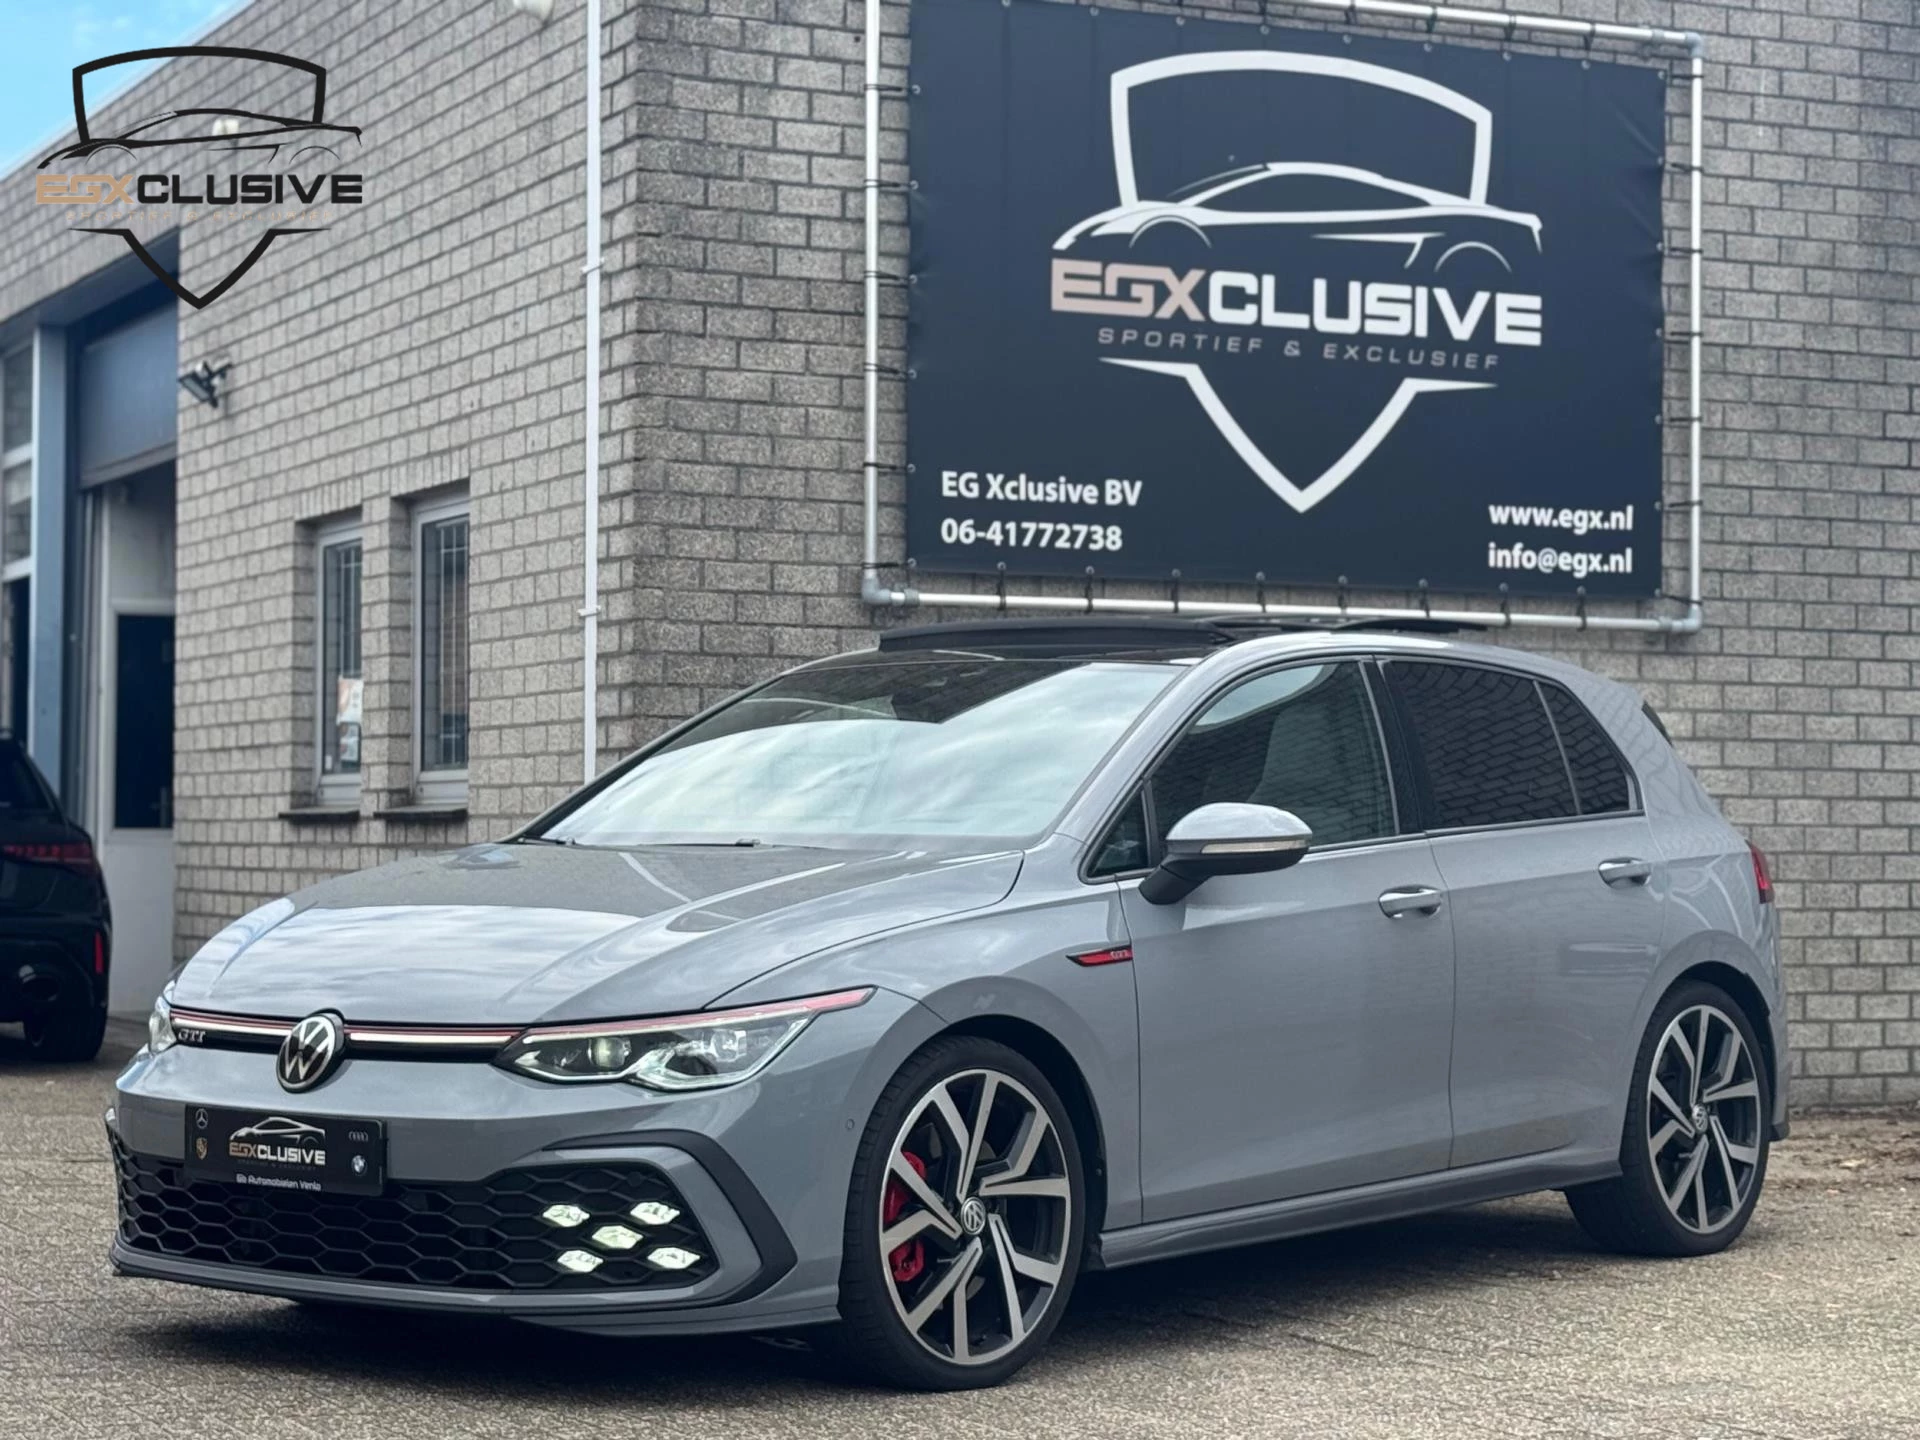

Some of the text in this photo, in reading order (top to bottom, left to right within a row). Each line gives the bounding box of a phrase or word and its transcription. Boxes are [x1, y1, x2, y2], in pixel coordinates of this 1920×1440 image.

[1051, 258, 1542, 346] EGXCLUSIVE
[1098, 327, 1501, 370] SPORTIEF & EXCLUSIEF
[941, 470, 1143, 506] EG Xclusive BV
[941, 518, 1123, 551] 06-41772738
[1488, 504, 1634, 536] www.egx.nl
[1488, 541, 1633, 579] info@egx.nl
[177, 1028, 206, 1043] GTI
[229, 1141, 326, 1166] EGXCLUSIVE
